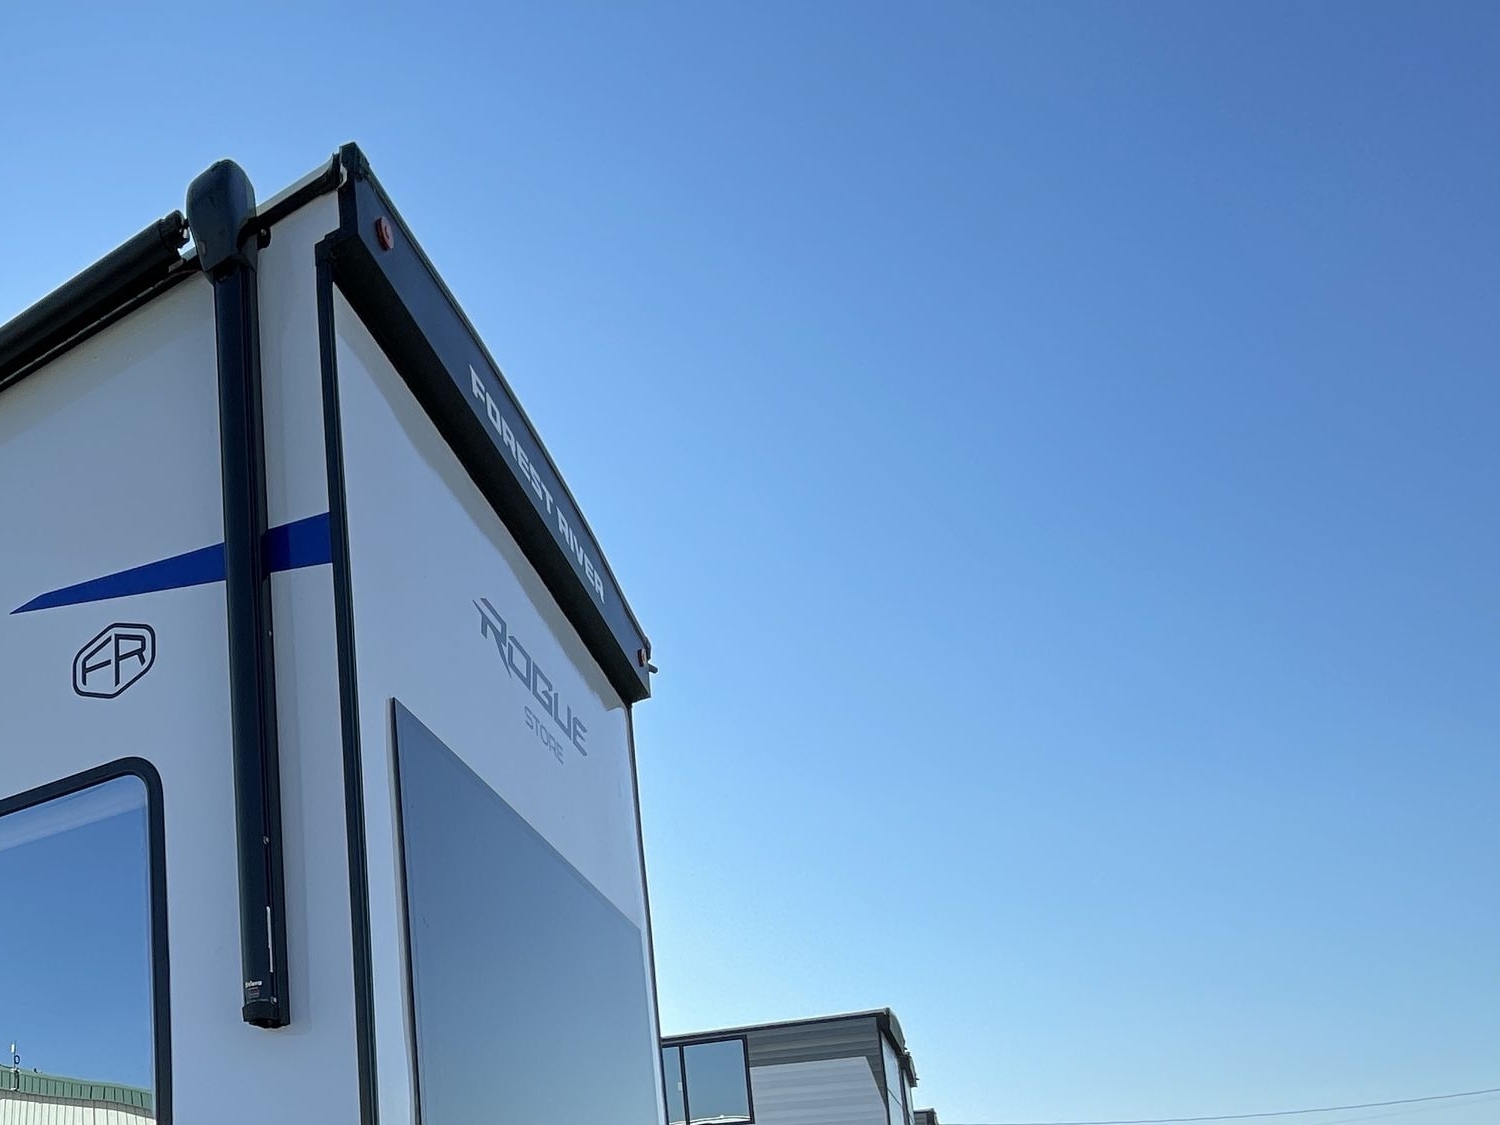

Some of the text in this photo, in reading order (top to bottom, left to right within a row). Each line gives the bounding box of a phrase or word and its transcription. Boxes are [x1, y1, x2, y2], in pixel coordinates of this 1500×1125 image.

[468, 363, 606, 605] FOREST RIVER
[471, 596, 589, 758] ROGUE
[523, 705, 565, 766] STORE
